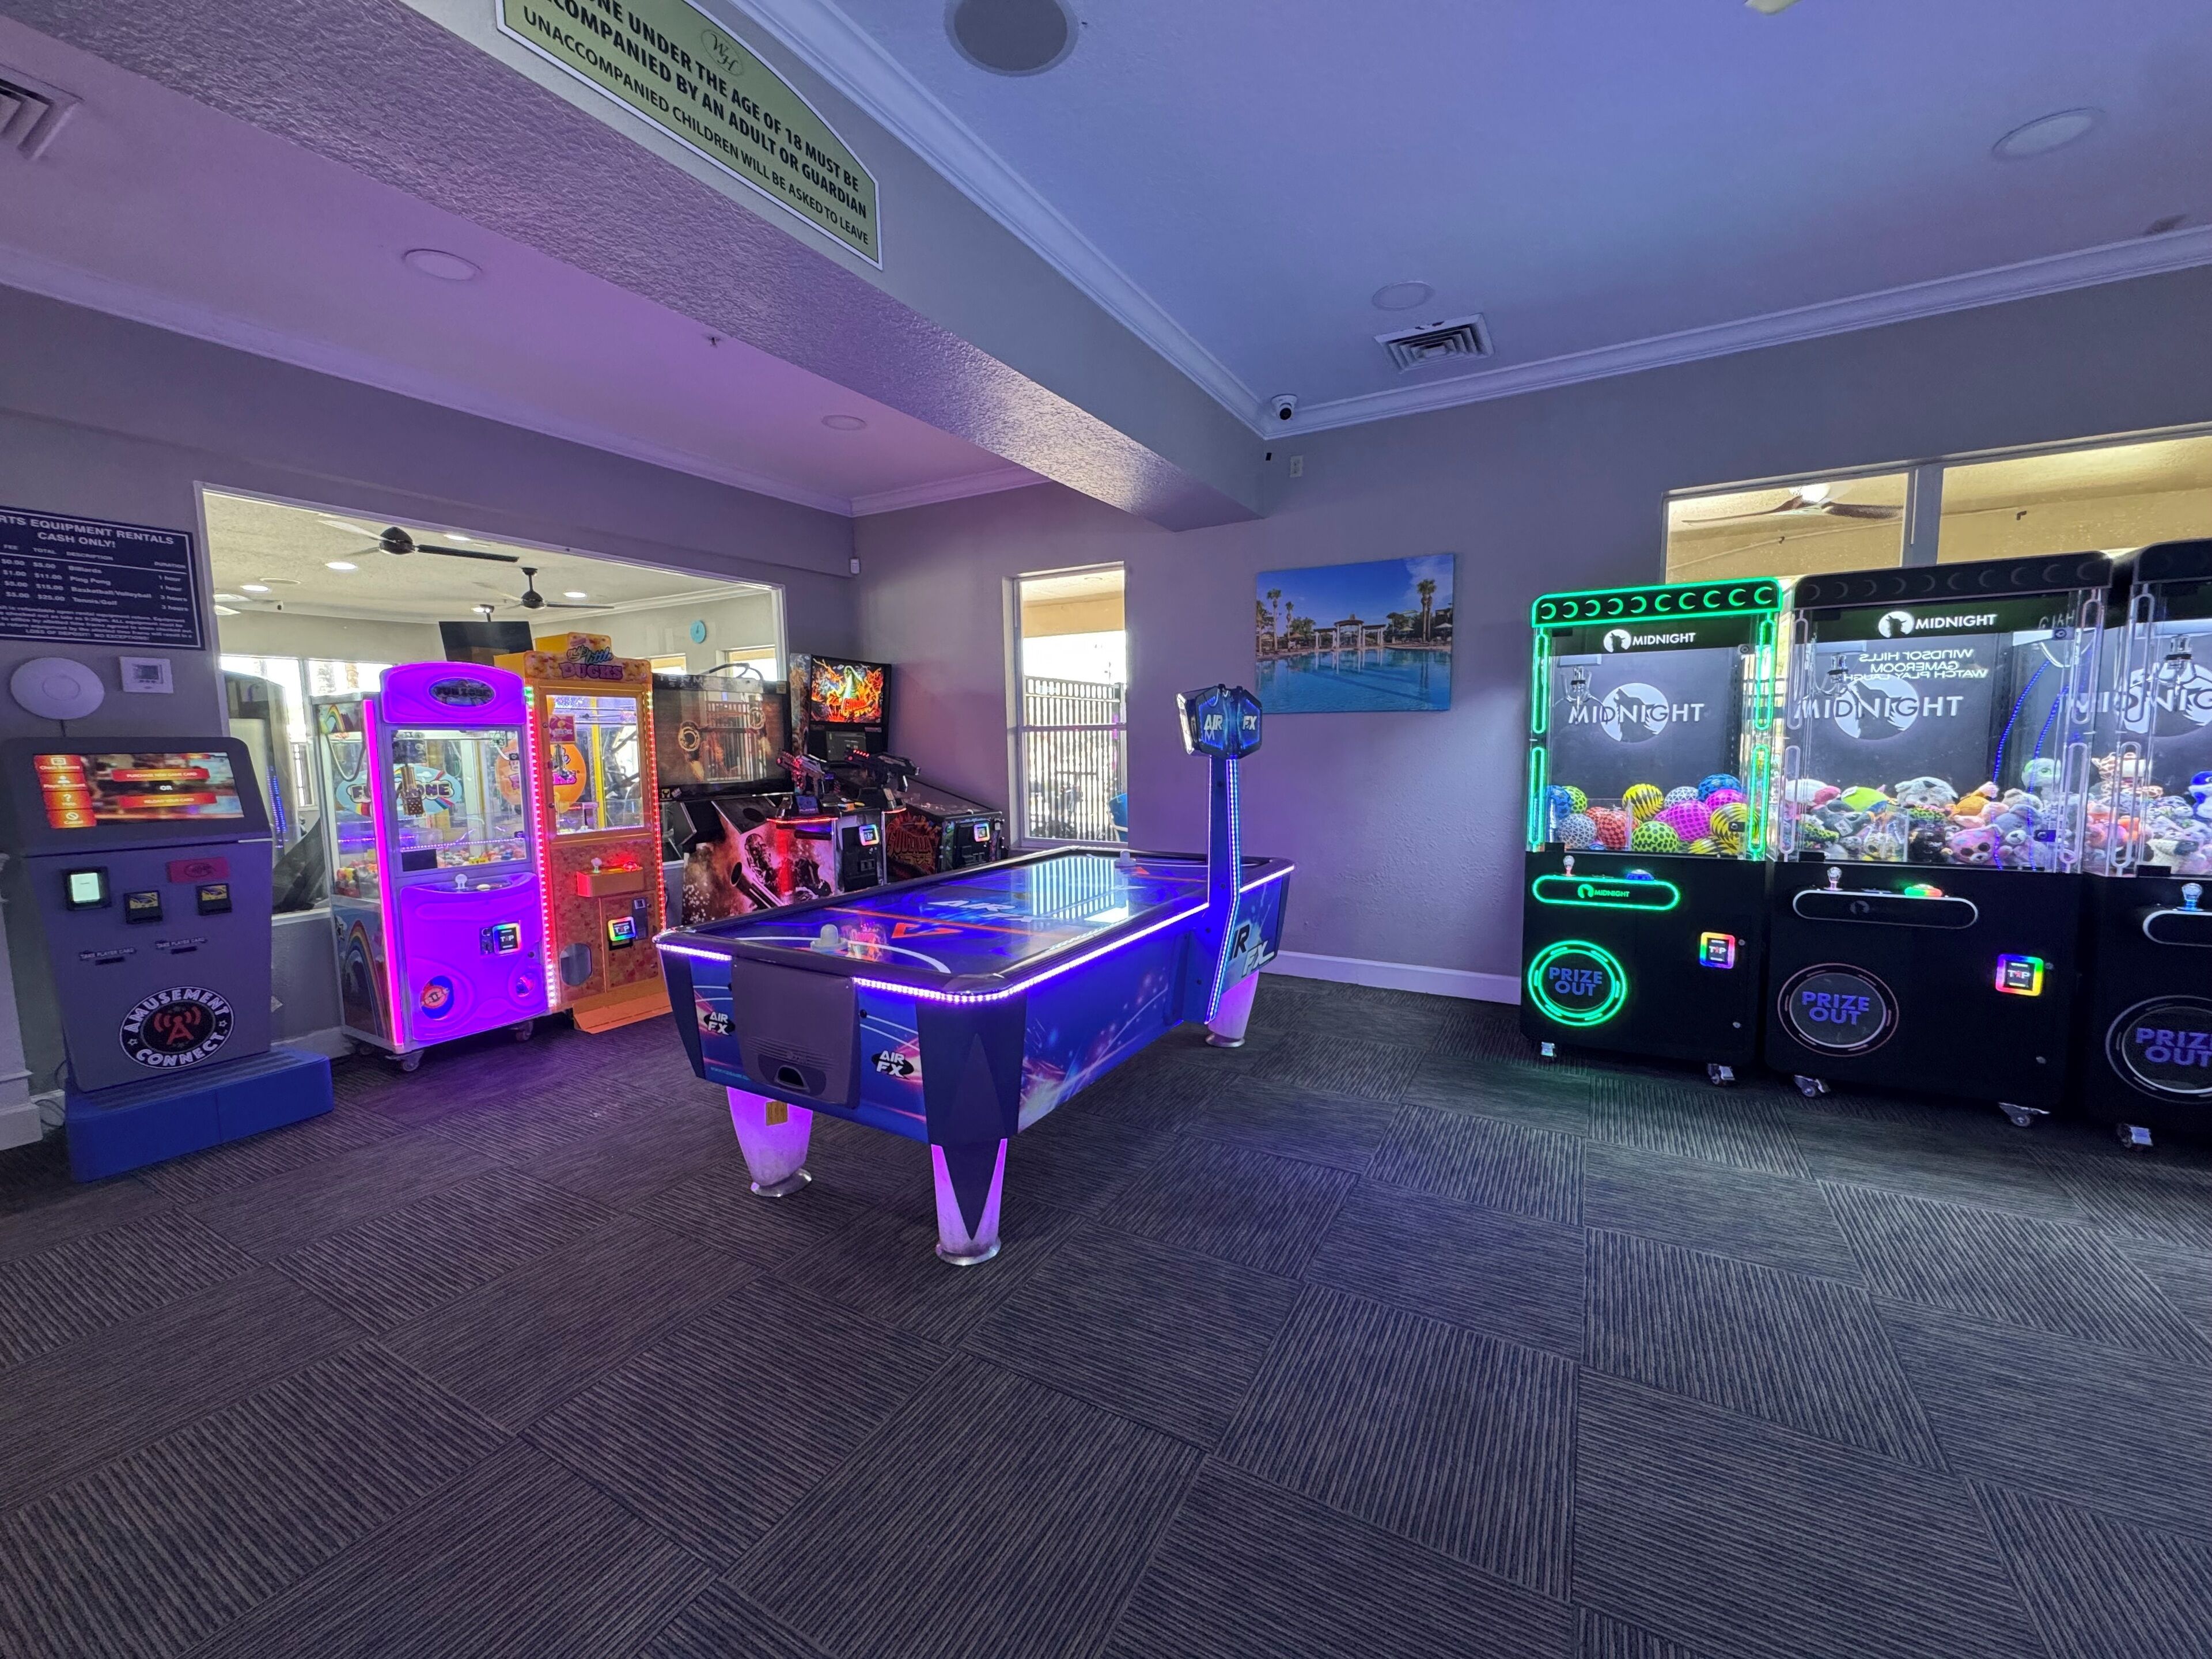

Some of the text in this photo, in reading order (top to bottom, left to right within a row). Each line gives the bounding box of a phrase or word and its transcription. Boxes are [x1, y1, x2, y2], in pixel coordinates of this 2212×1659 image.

[628, 12, 691, 73] UNDER
[695, 61, 727, 97] THE
[731, 88, 760, 122] AGE
[764, 112, 782, 134] OF
[786, 128, 802, 151] 18
[806, 141, 841, 178] MUST
[844, 170, 858, 192] BE
[524, 5, 869, 245] UNACCOMPANIED CHILDREN WILL BE ASKED TO LEAVE
[676, 73, 698, 101] BY
[702, 93, 725, 121] AN
[729, 111, 776, 155] ADULT
[779, 147, 799, 172] OR
[802, 163, 866, 219] GUARDIAN
[30, 518, 112, 536] EQUIPMENT
[116, 530, 174, 545] RENTALS
[37, 532, 116, 548] CASH ONLY!
[1915, 613, 1998, 630] MIDNIGHT
[1632, 632, 1696, 646] MIDNIGHT
[559, 662, 623, 680] DUCKS
[1568, 703, 1705, 725] MIDNIGHT
[1793, 695, 1964, 719] MIDNIGHT
[1203, 714, 1257, 731] AIR FX
[1594, 889, 1630, 897] MIDNIGHT
[1549, 967, 1603, 984] PRIZE
[1555, 980, 1597, 997] OUT
[123, 988, 230, 1033] AMUSEMENT
[1801, 991, 1871, 1012] PRIZE
[709, 1011, 729, 1024] AIR
[1809, 1006, 1862, 1026] OUT
[708, 1021, 730, 1036] FX
[2135, 1027, 2212, 1050] PRIZ
[136, 1032, 225, 1067] CONNECT
[879, 1050, 905, 1065] AIR
[2145, 1046, 2212, 1067] OUT
[876, 1060, 906, 1078] FX
